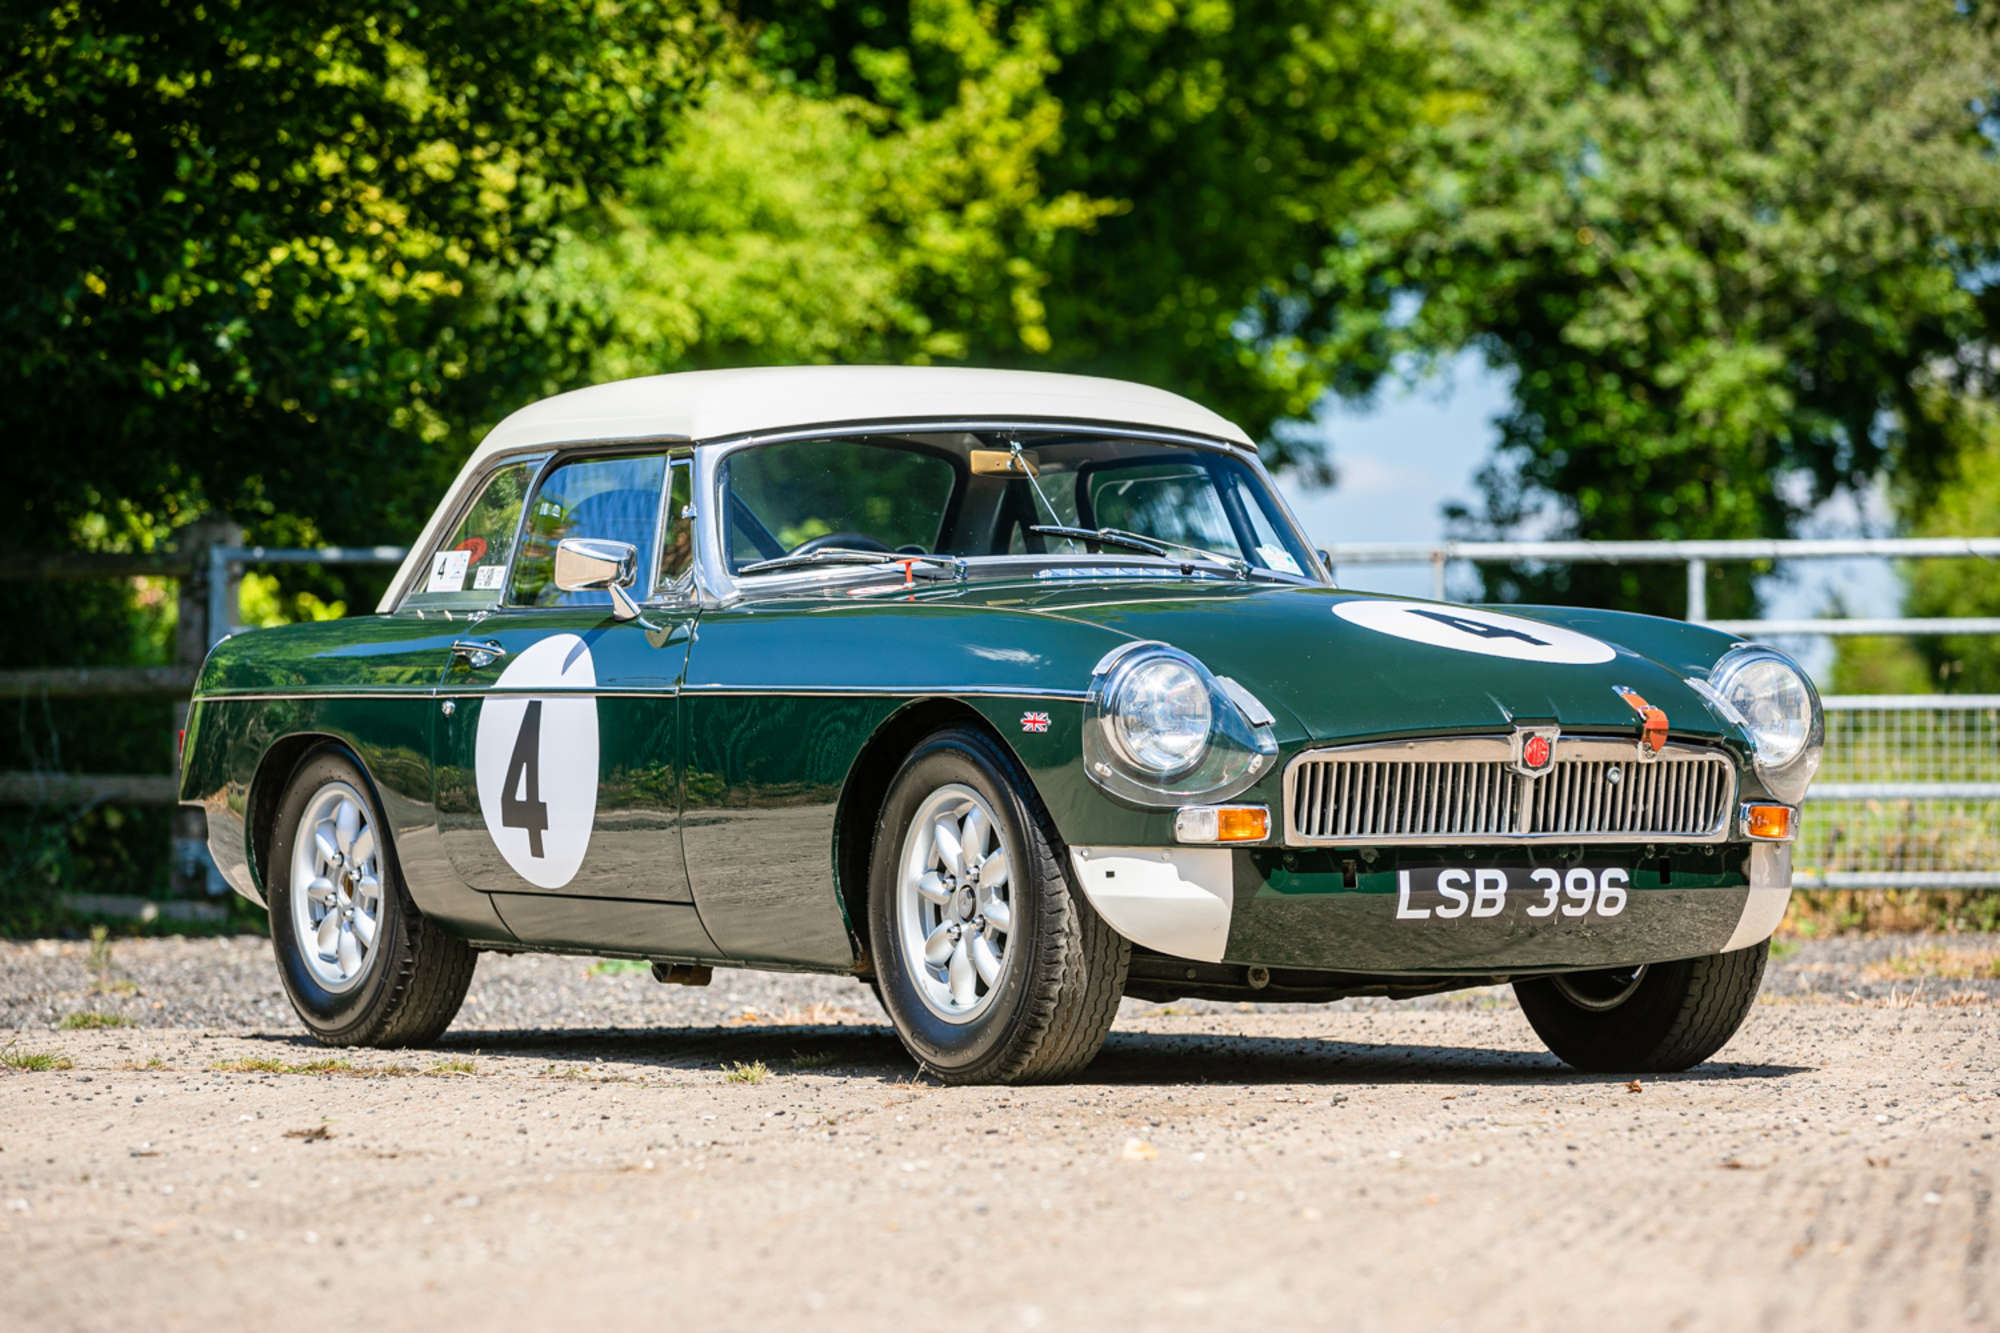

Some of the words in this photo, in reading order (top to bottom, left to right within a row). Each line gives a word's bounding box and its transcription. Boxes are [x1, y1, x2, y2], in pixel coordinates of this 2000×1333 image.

[437, 557, 448, 580] 4
[1403, 609, 1552, 646] 4
[501, 700, 549, 858] 4
[1396, 868, 1508, 919] LSB
[1526, 867, 1630, 918] 396
